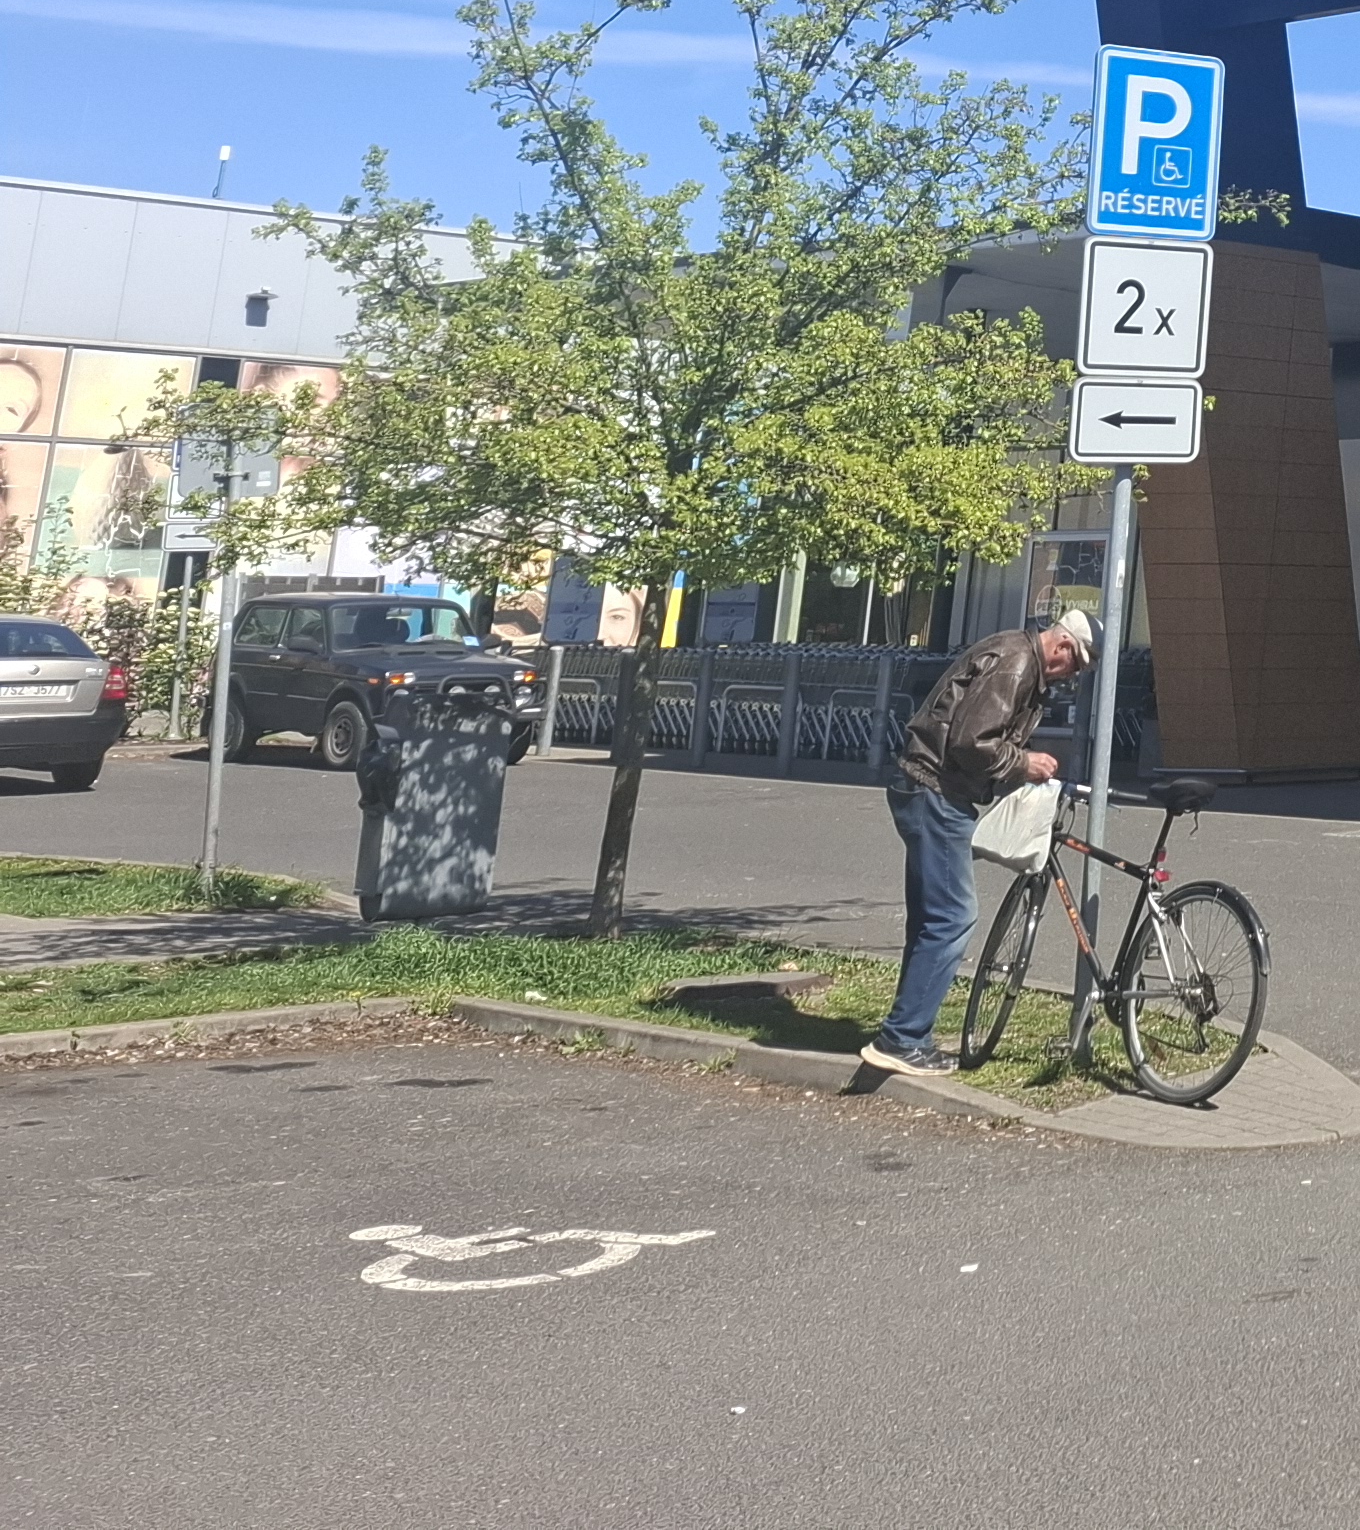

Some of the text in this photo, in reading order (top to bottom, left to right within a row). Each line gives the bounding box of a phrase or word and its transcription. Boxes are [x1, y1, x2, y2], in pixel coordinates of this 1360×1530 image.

[1120, 73, 1193, 175] P
[1100, 186, 1206, 220] RÉSERVÉ
[1113, 278, 1177, 337] 2 x
